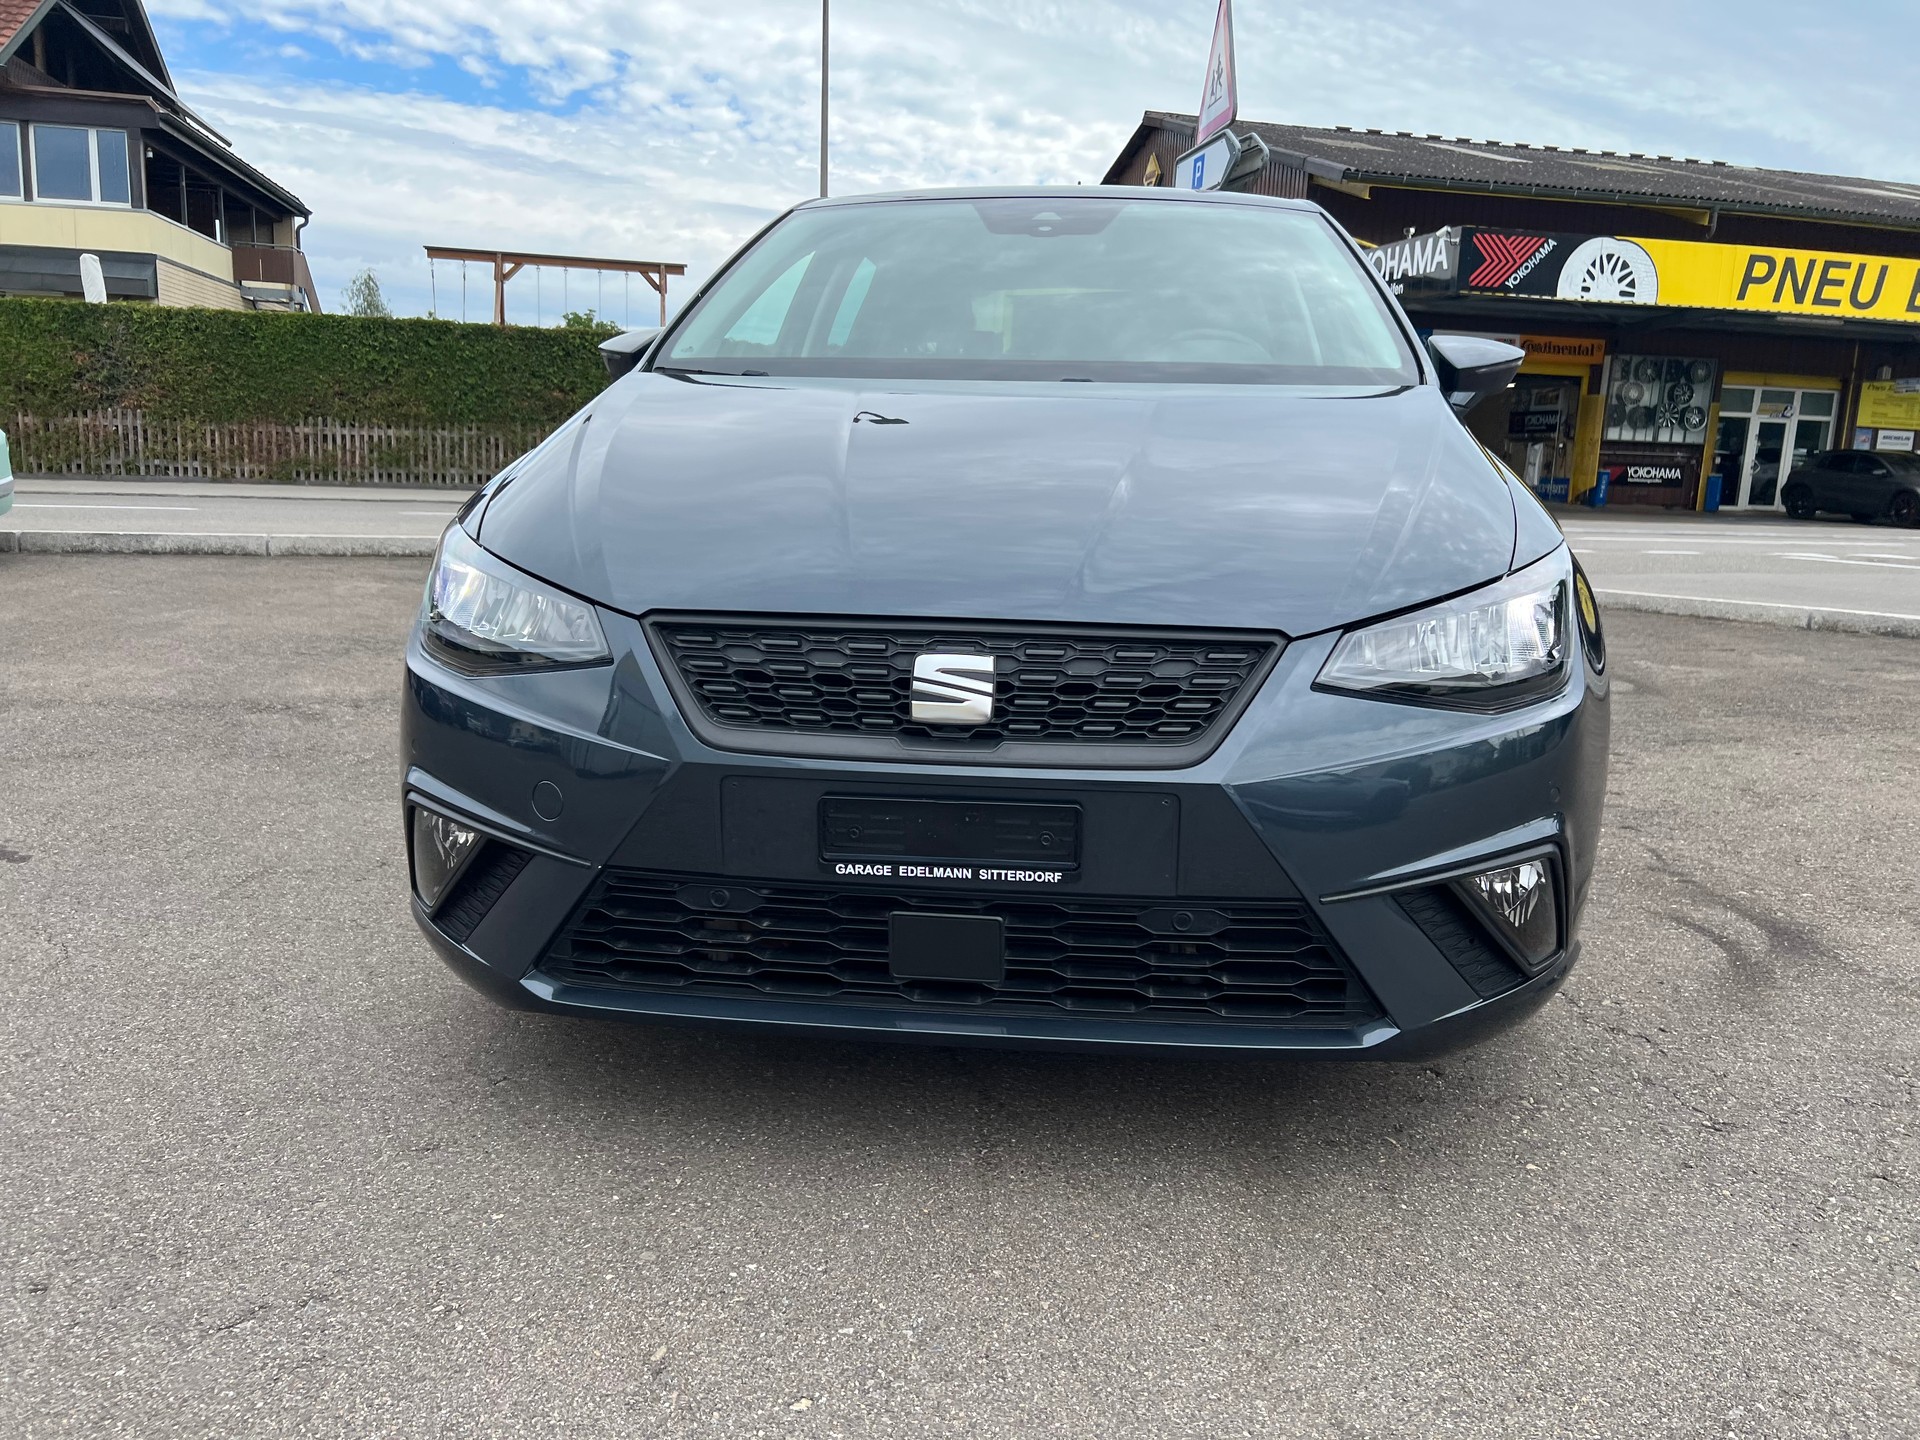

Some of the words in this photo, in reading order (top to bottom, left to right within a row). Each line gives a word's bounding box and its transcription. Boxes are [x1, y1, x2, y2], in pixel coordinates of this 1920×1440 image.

[1367, 237, 1448, 281] OHAMA
[1505, 238, 1558, 289] YOKOHAMA
[1736, 254, 1889, 310] PNEU
[1627, 466, 1681, 480] YOKOHAMA
[835, 863, 892, 876] GARAGE
[899, 865, 972, 879] EDELMANN
[979, 868, 1063, 883] SITTERDORF
